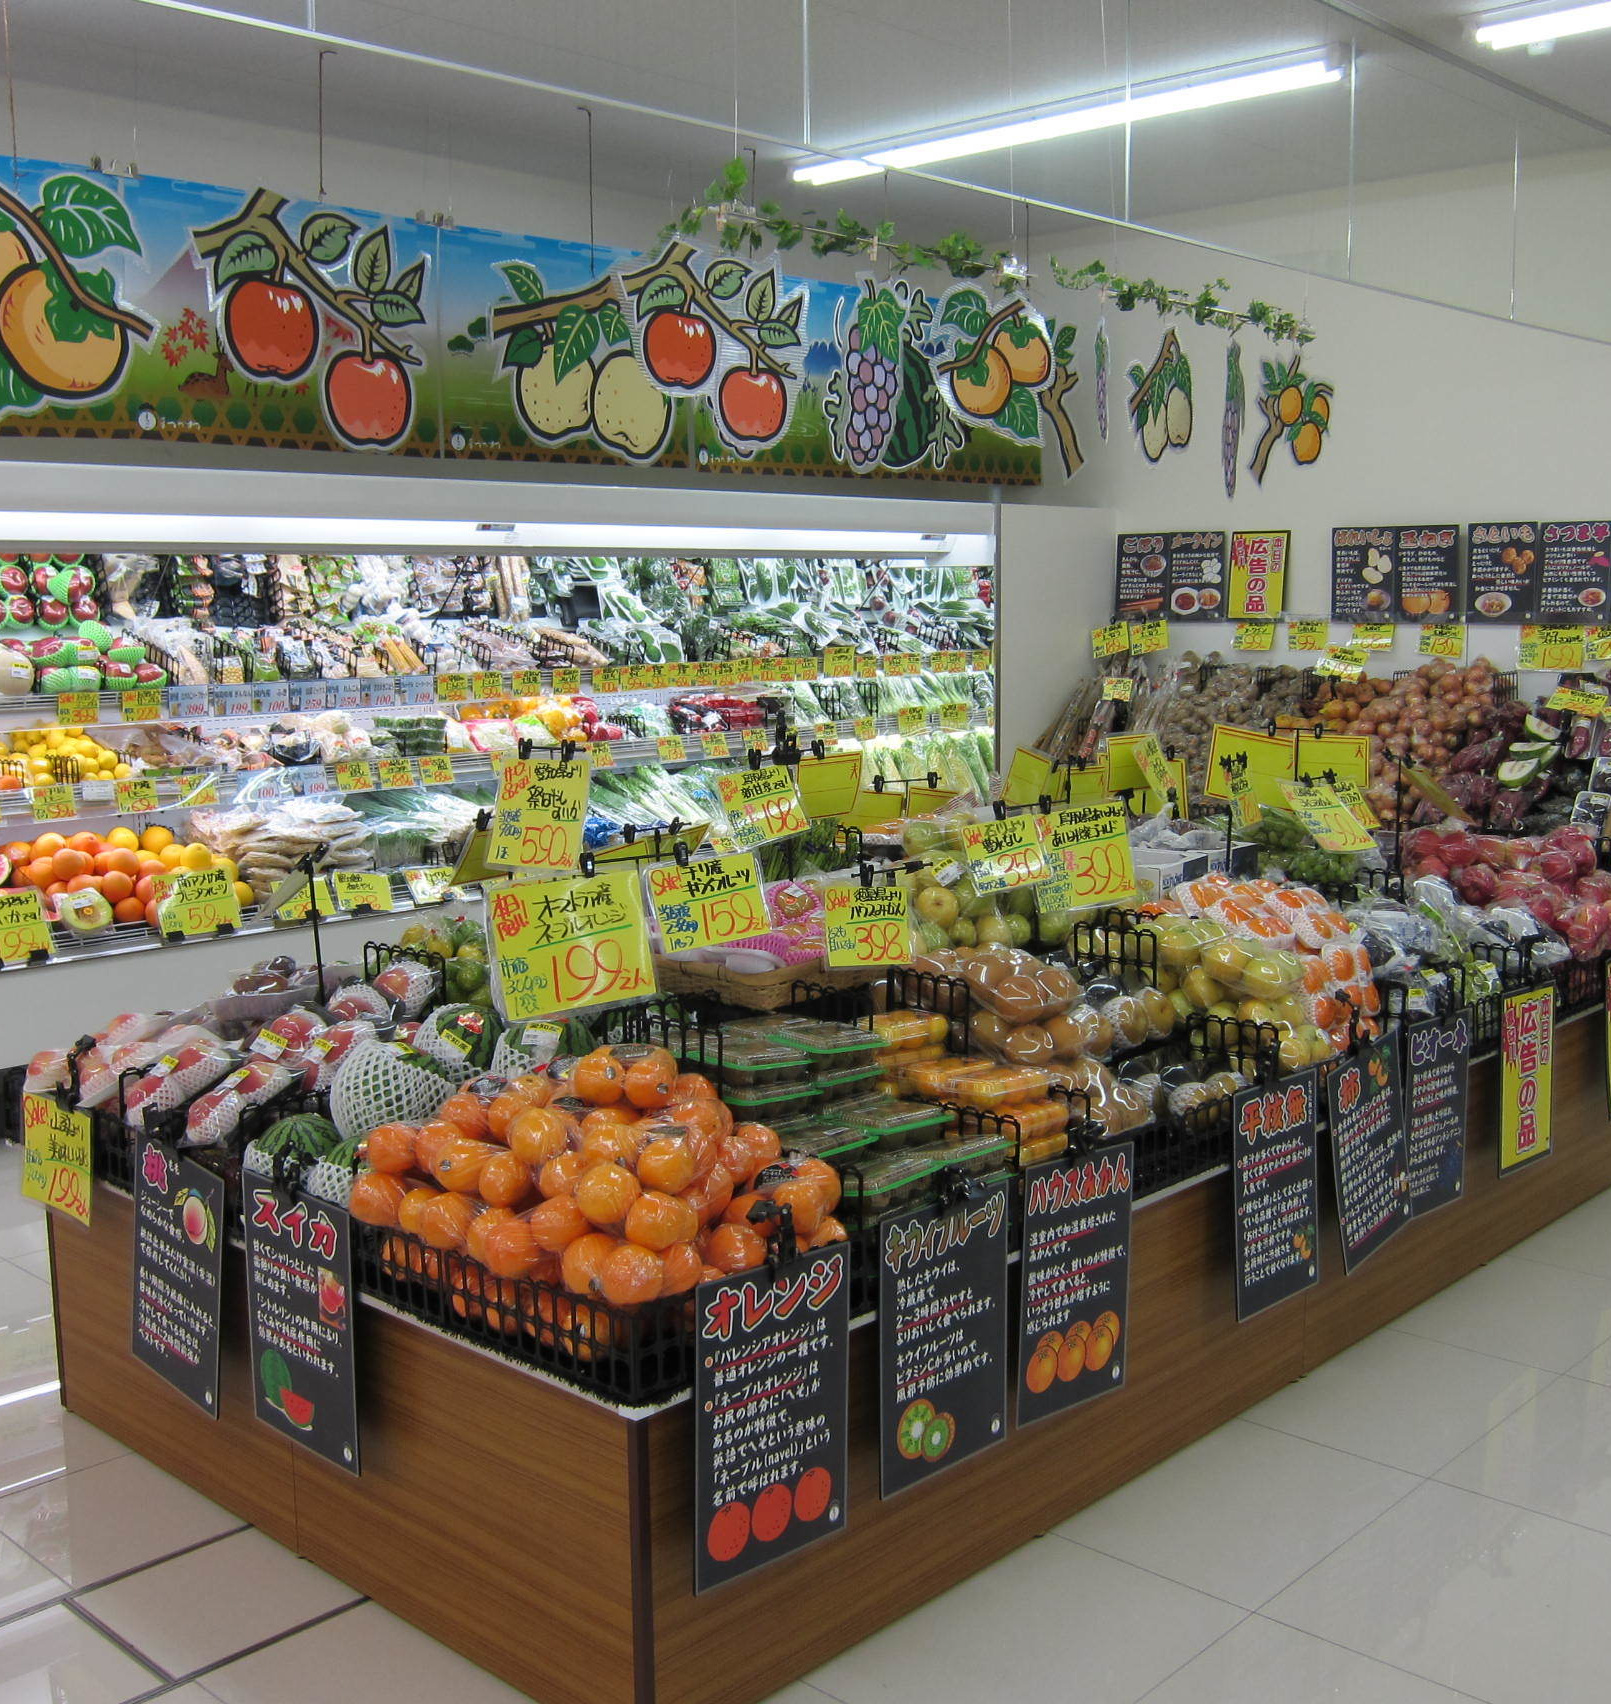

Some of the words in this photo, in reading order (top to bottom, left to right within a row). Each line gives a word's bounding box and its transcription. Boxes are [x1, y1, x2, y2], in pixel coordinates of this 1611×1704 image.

[1123, 536, 1164, 553] ごぼう
[1171, 532, 1223, 549] メークイン
[1472, 524, 1535, 544] さといも
[1543, 522, 1610, 542] さつま芋
[1244, 537, 1270, 614] 広告の品
[981, 833, 1023, 855] 豊水なし
[681, 859, 725, 881] チリ産
[850, 901, 906, 920] ハウスみかん
[1338, 1068, 1361, 1114] 柿
[1516, 999, 1539, 1155] 広告の品
[23, 1095, 49, 1128] Sale!
[1239, 1085, 1307, 1145] 平核無
[142, 1142, 169, 1194] 桃
[1028, 1152, 1130, 1216] ハウスみかん
[1243, 1175, 1269, 1197] 人気です。
[140, 1188, 173, 1220] ジューシーで
[252, 1188, 337, 1260] スイカ
[885, 1191, 1005, 1274] キウイフルーツ
[1029, 1210, 1116, 1247] 温室内で加温栽培された
[252, 1237, 314, 1278] 甘くてシャリっとした
[1029, 1240, 1071, 1262] みかんです。
[702, 1254, 843, 1342] オレンジ
[896, 1284, 936, 1311] 冷蔵庫で
[897, 1260, 960, 1295] 熟したキウイは、
[1027, 1273, 1090, 1301] 冷やして食べると、
[256, 1292, 341, 1348] 「シトルリン」の作用により、
[257, 1308, 320, 1353] むくみや利尿作用に
[896, 1296, 996, 1346] よりおいしく食べられます。
[1026, 1309, 1071, 1335] 感じられます
[138, 1326, 168, 1358] ベストです。
[258, 1324, 339, 1379] 効果があるといわれます。
[713, 1336, 834, 1387] 普通オレンジの一種です。
[896, 1329, 965, 1367] キウイフルーツは
[896, 1340, 978, 1385] ビタミンCが多いので
[896, 1352, 994, 1404] 風邪予防に効果的です。
[713, 1378, 821, 1430] お尻の部分に「へそ」が
[713, 1408, 793, 1449] あるのが特徴で、
[713, 1414, 826, 1471] 英語でへそという意味の
[712, 1460, 805, 1507] 名前で呼ばれます。
